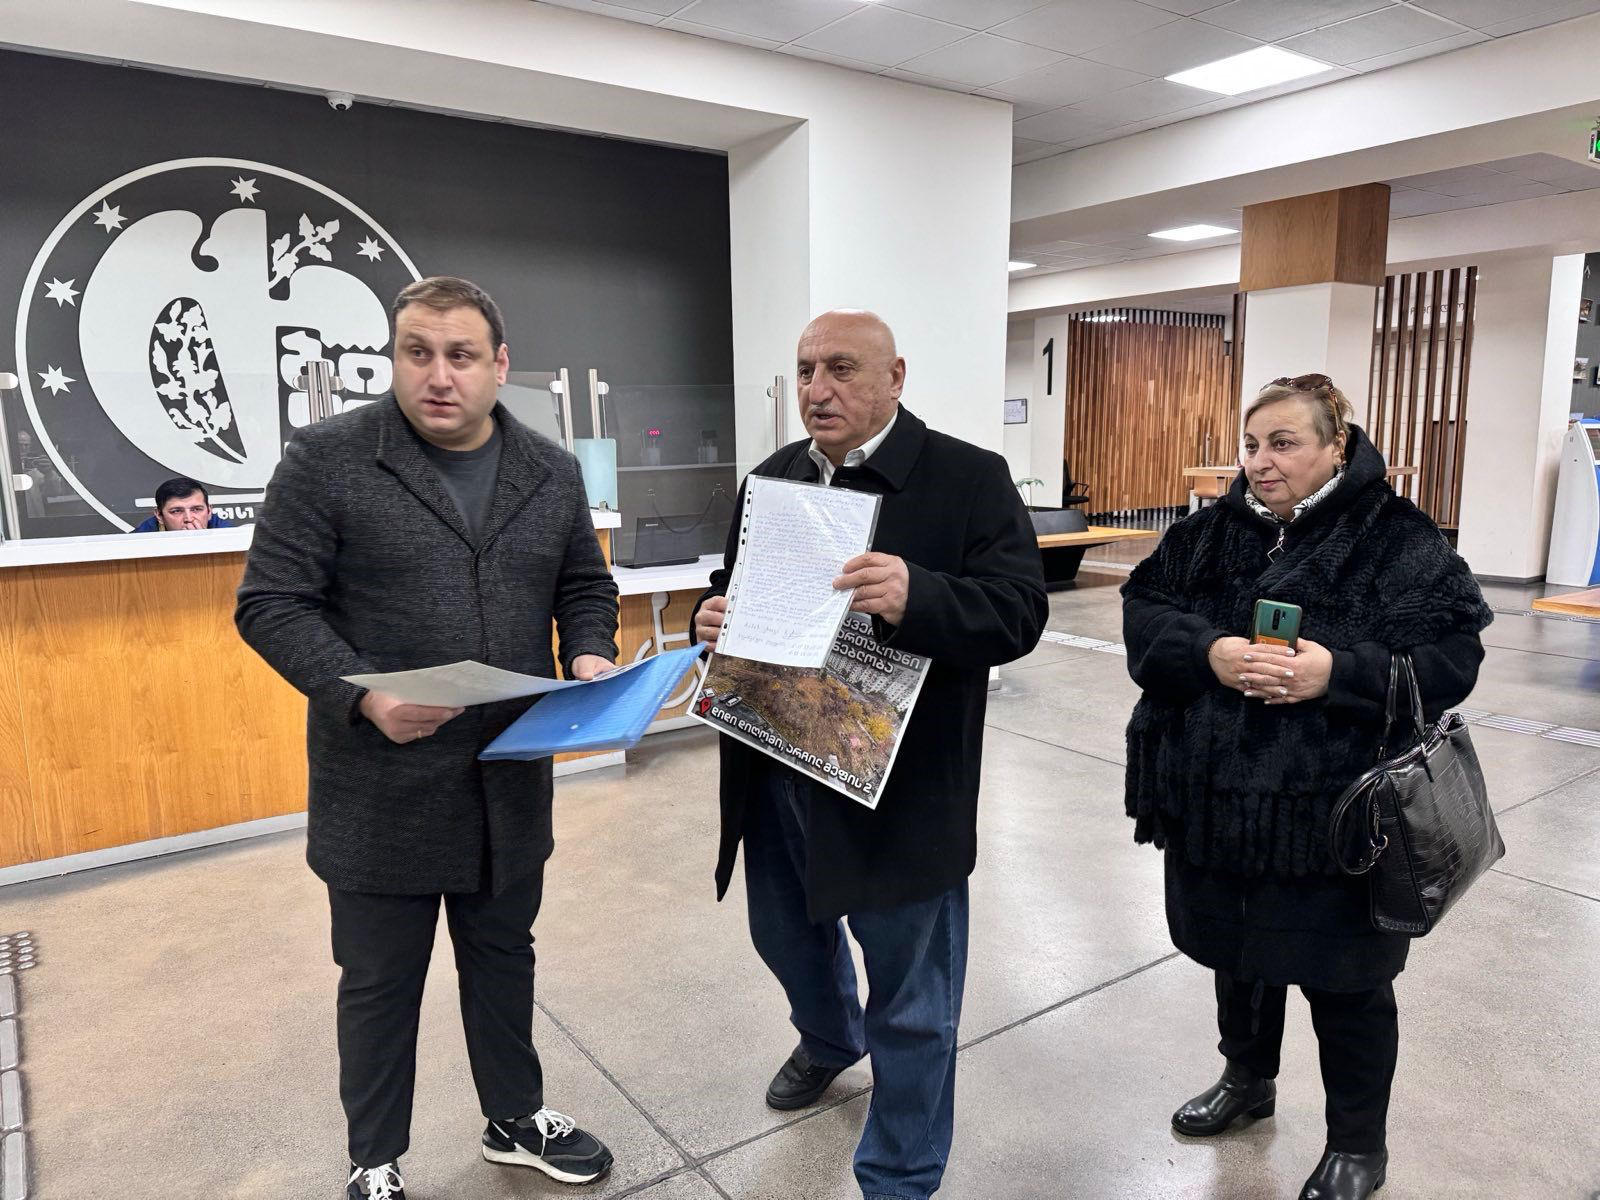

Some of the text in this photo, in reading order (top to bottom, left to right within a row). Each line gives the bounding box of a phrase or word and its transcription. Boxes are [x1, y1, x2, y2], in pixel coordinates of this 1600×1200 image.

[1043, 338, 1053, 395] 1
[832, 641, 894, 674] ნებლობა
[838, 629, 921, 669] ართულიანი
[862, 782, 872, 793] 2
